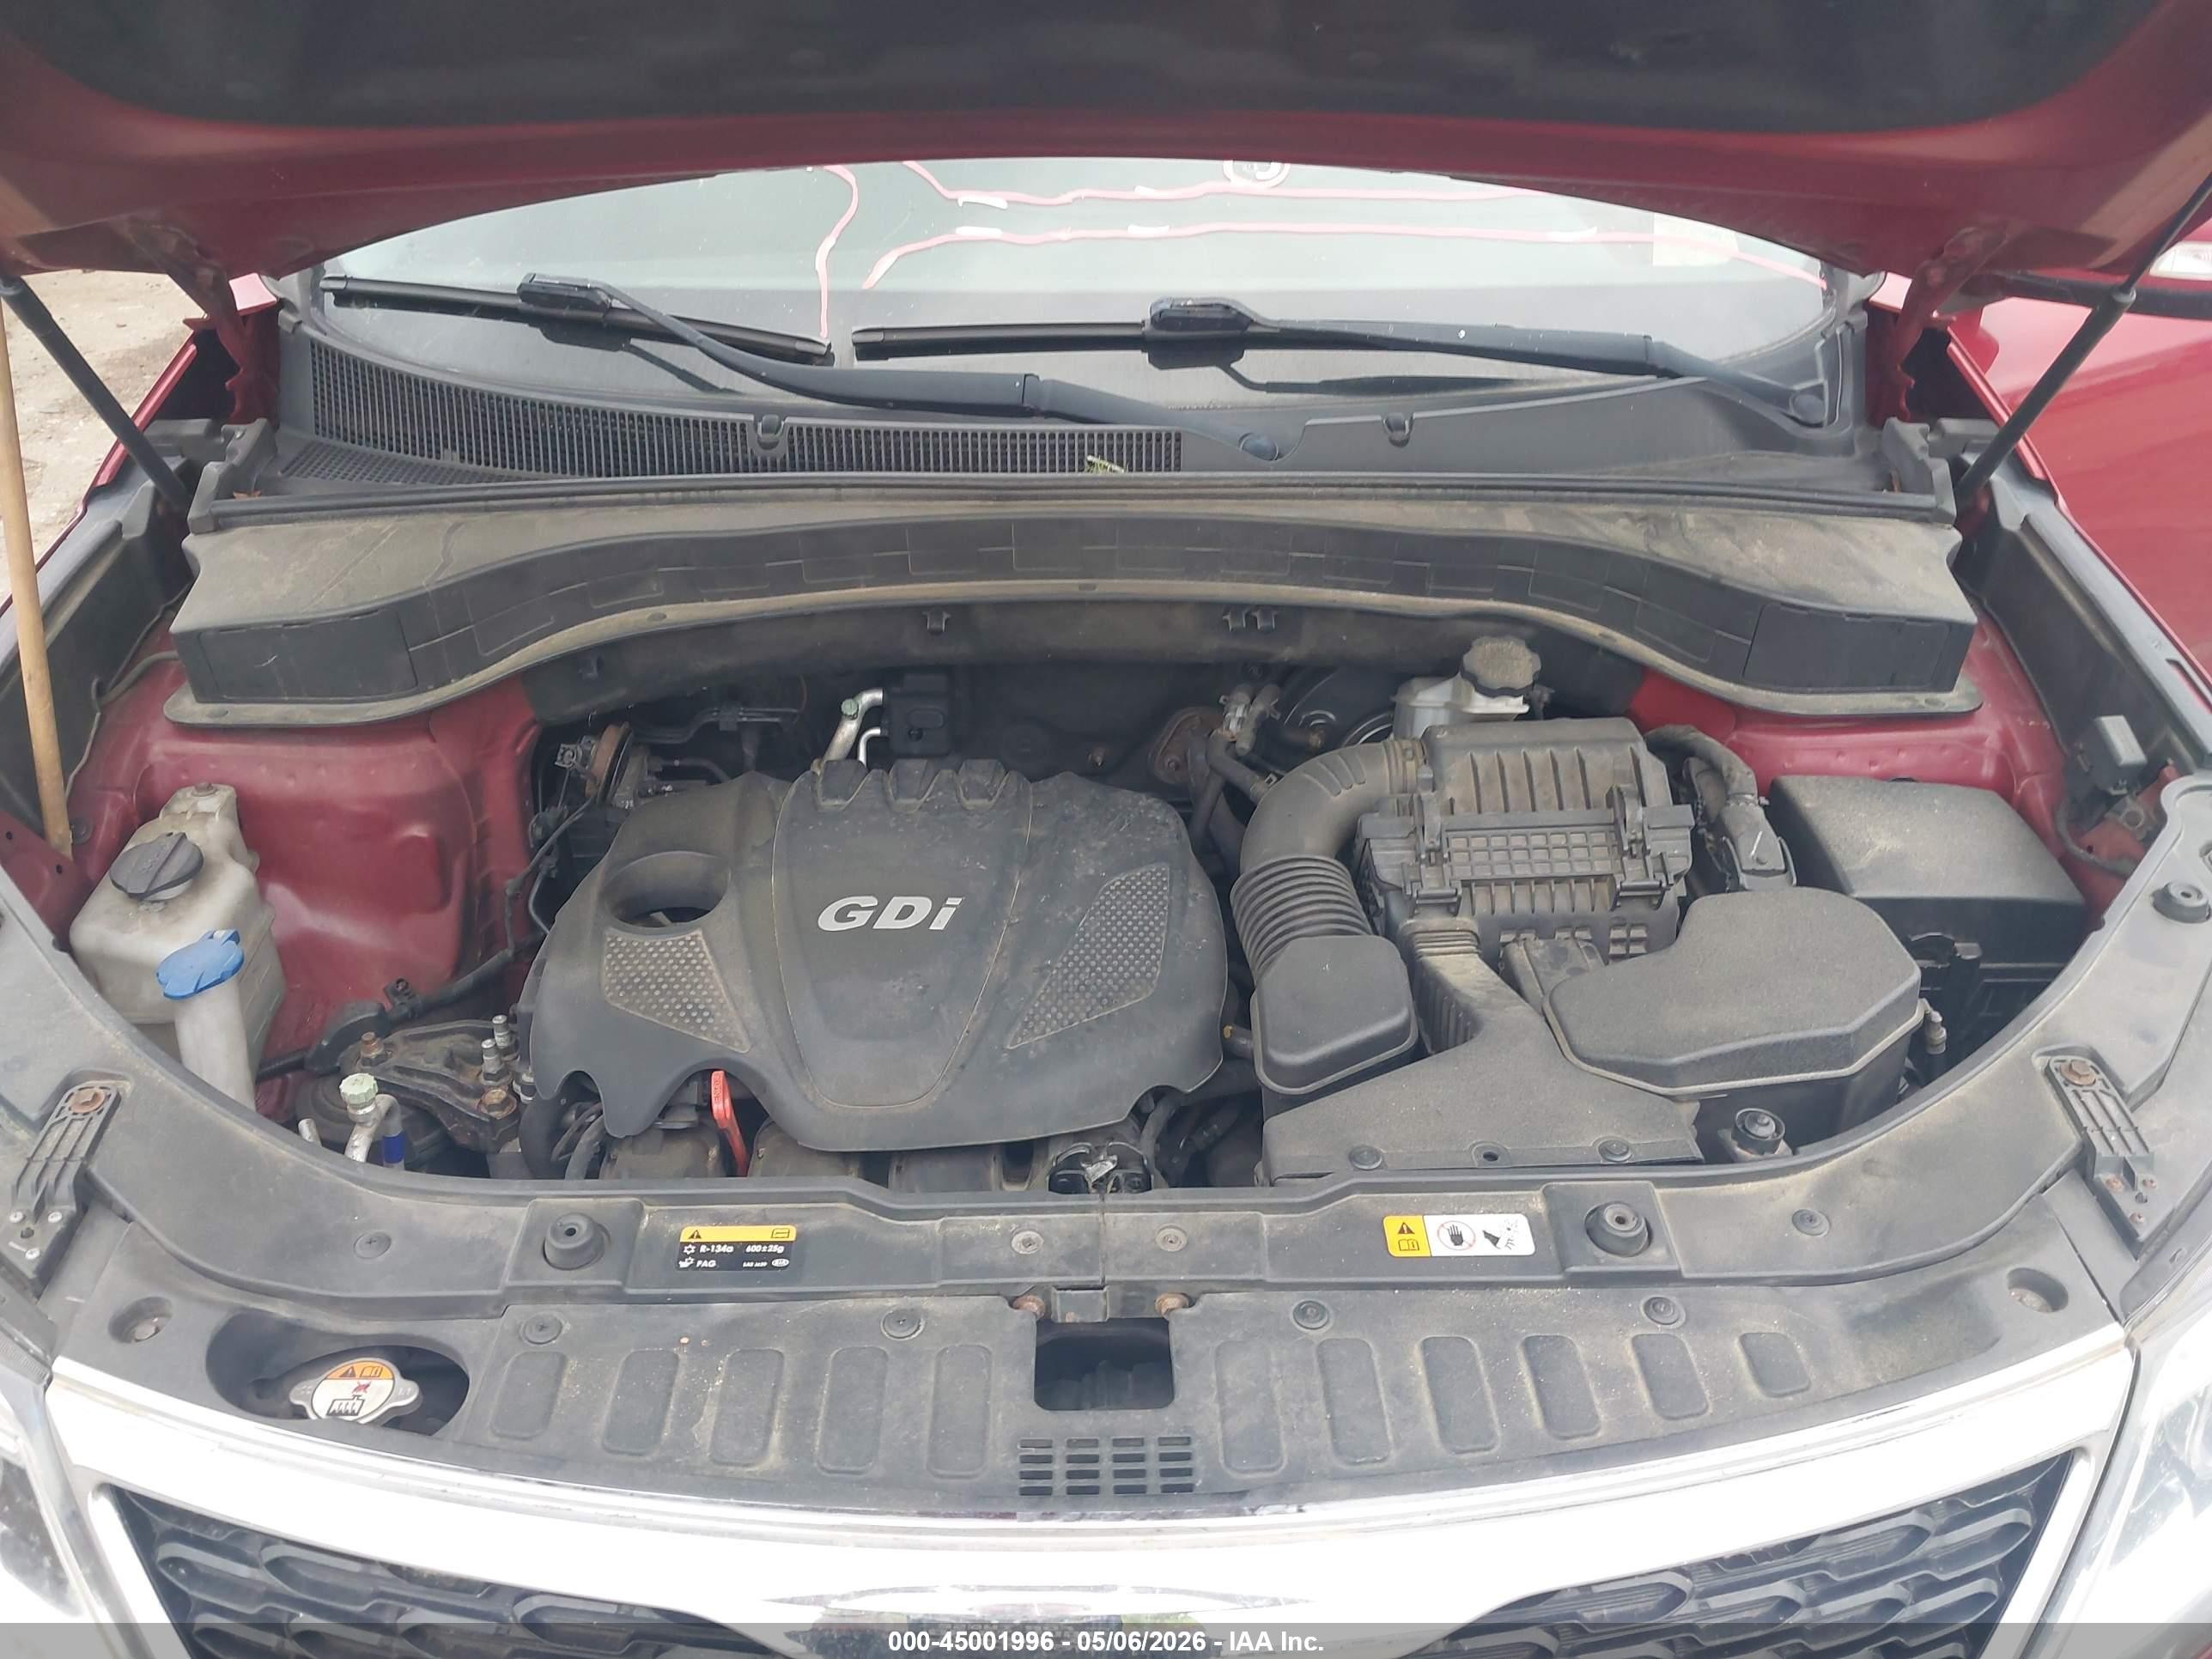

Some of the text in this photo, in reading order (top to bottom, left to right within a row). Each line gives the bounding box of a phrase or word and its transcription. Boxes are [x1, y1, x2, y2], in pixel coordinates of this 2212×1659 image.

[817, 896, 963, 932] GDi
[699, 1244, 785, 1254] R-134a 600±25g
